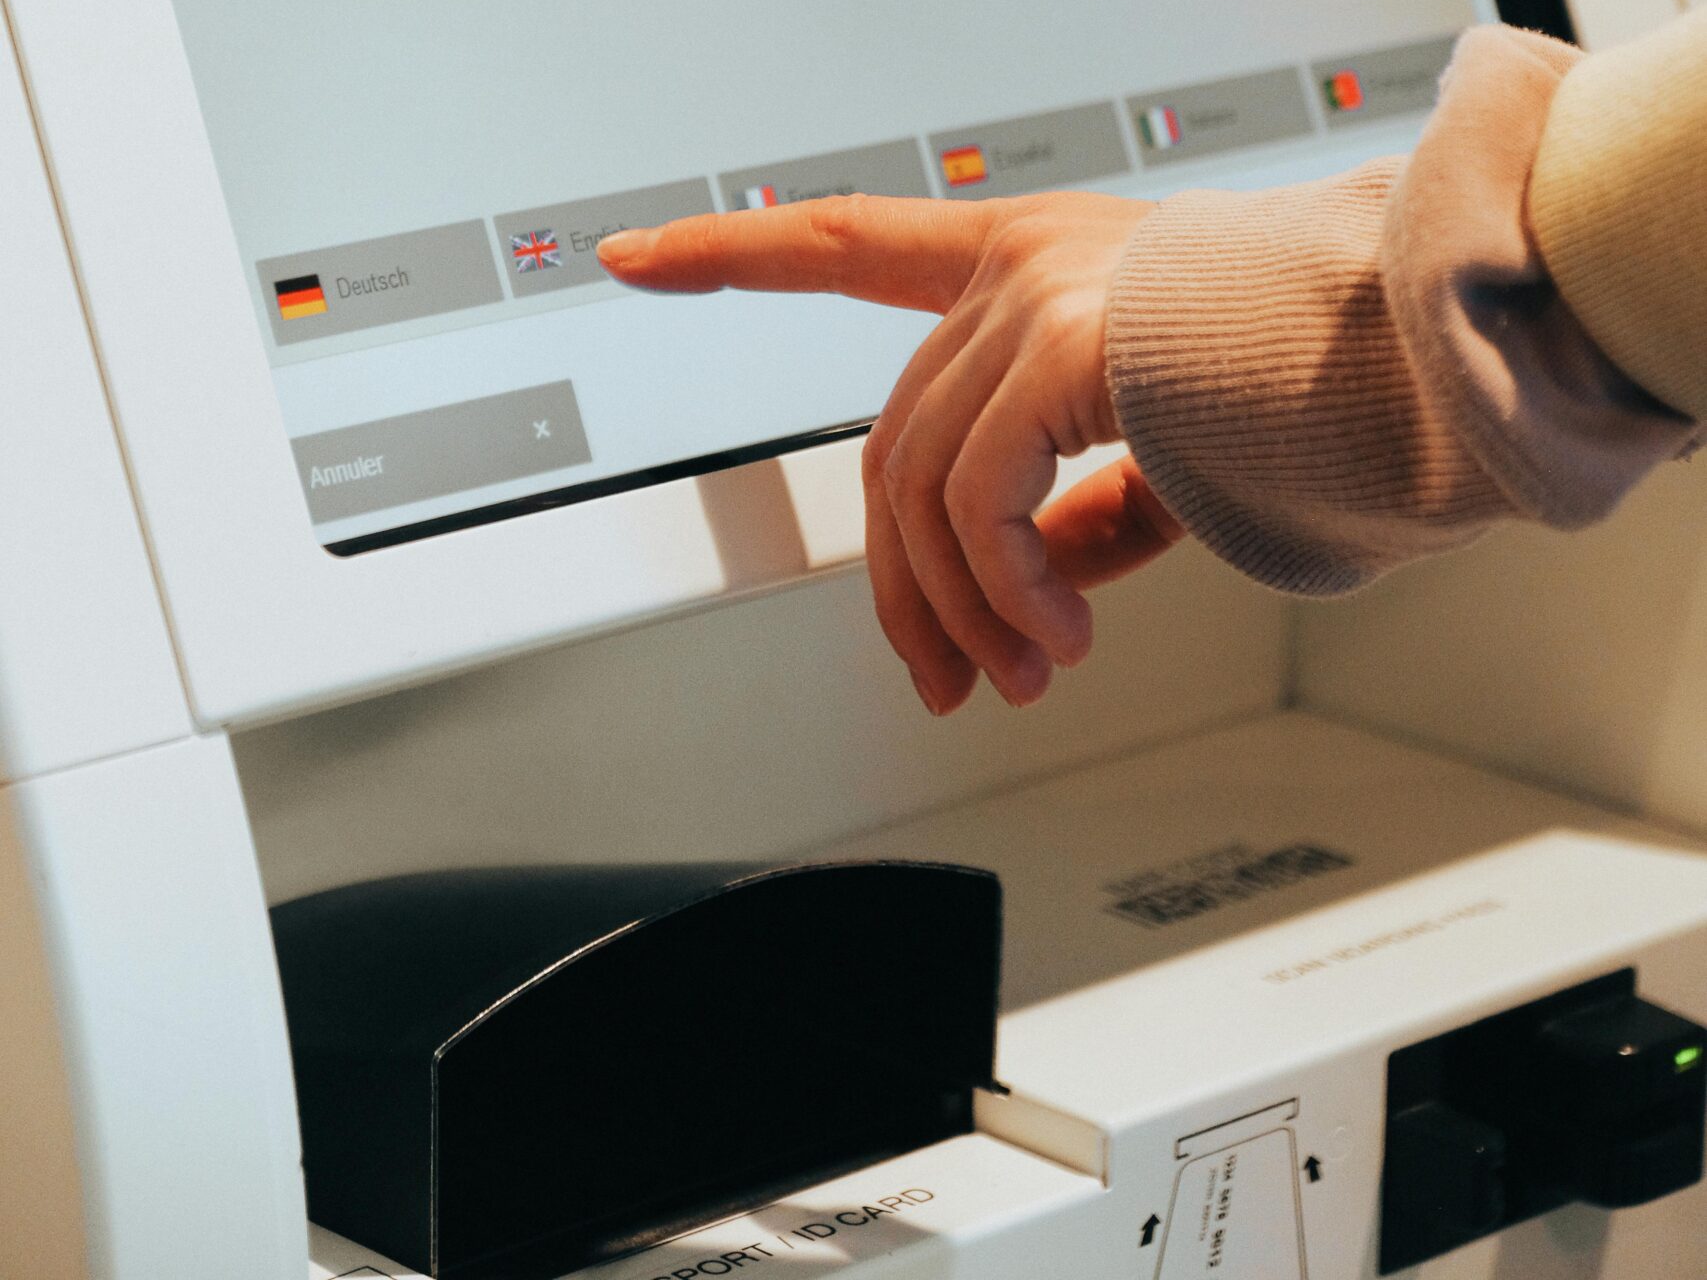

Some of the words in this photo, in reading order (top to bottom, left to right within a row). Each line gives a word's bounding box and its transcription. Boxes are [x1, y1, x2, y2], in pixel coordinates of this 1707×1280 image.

[336, 265, 410, 300] Deutsch
[310, 455, 384, 489] Annuler
[791, 1222, 837, 1242] ID
[835, 1188, 934, 1227] CARD
